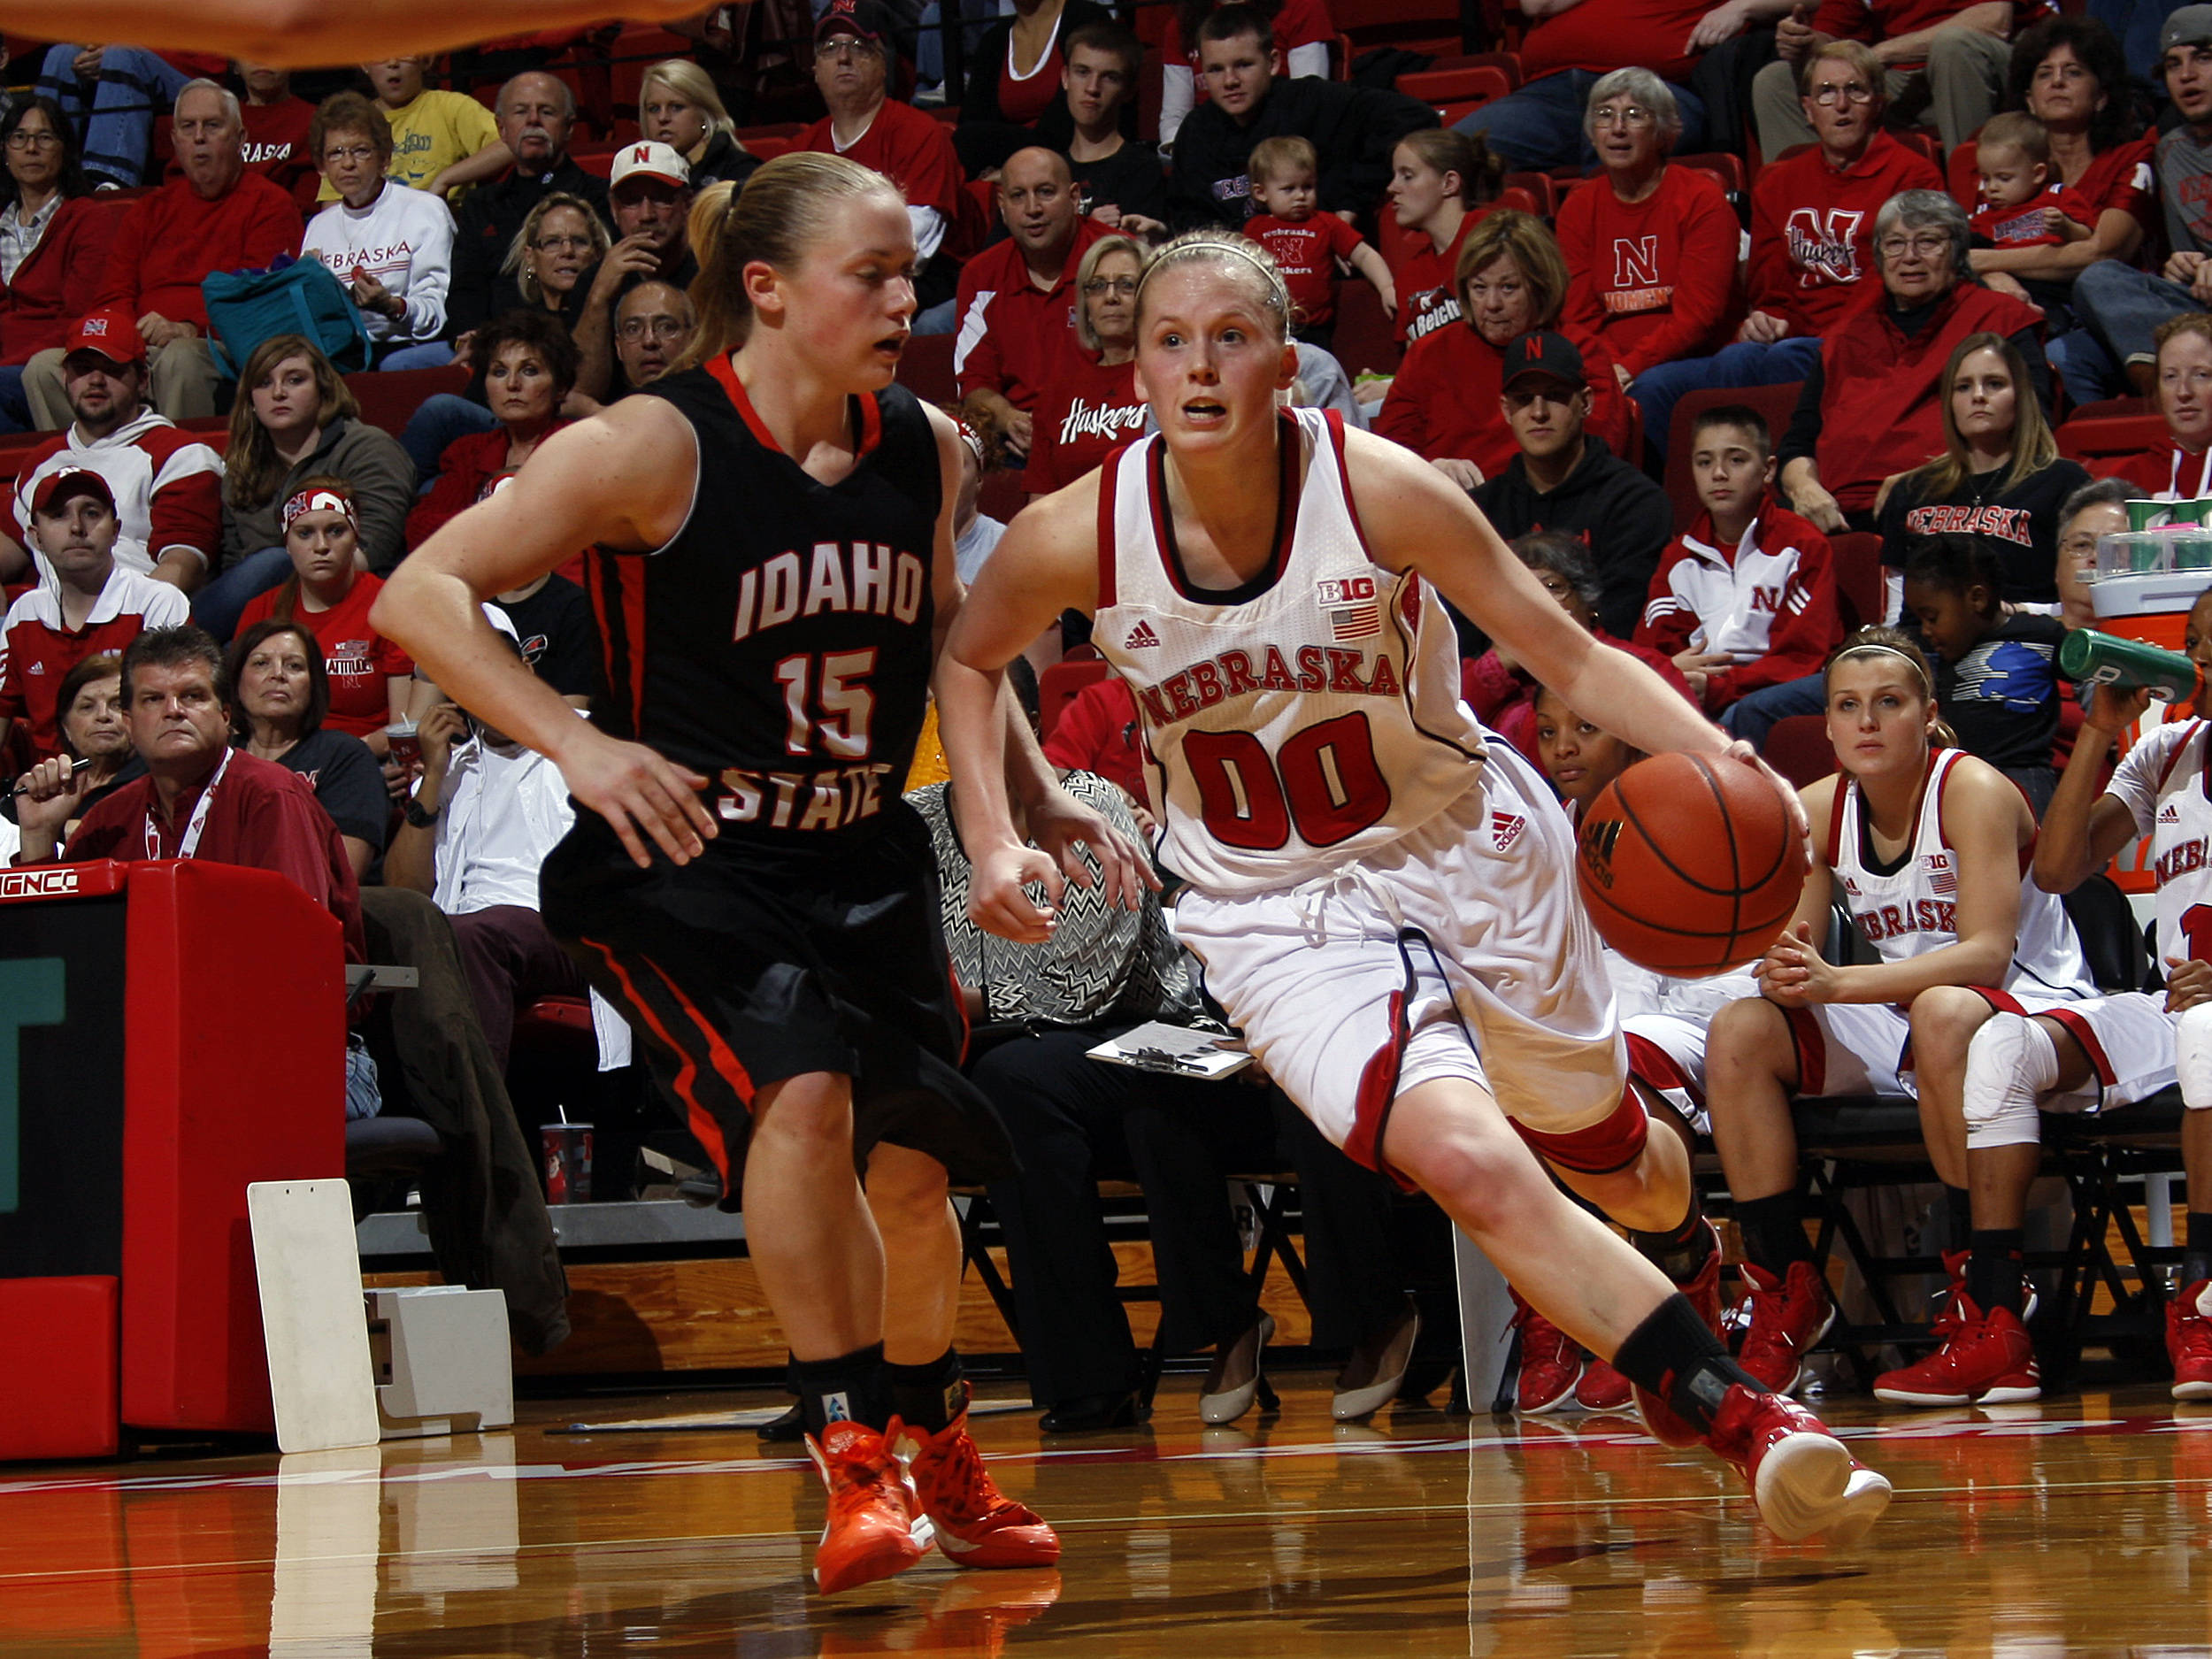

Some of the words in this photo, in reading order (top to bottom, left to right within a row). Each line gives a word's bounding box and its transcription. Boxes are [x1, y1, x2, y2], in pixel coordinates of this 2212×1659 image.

[634, 146, 651, 164] N
[1272, 237, 1304, 264] N
[1614, 235, 1658, 287] N
[1525, 335, 1543, 361] N
[1060, 397, 1148, 444] Huskers
[731, 540, 924, 644] IDAHO
[1752, 587, 1779, 611] N
[1125, 640, 1160, 649] adidas
[772, 645, 879, 759] 15
[1139, 645, 1400, 728] NEBRASKA
[716, 762, 895, 831] STATE
[1182, 710, 1391, 849] 00
[1496, 816, 1525, 851] adidas
